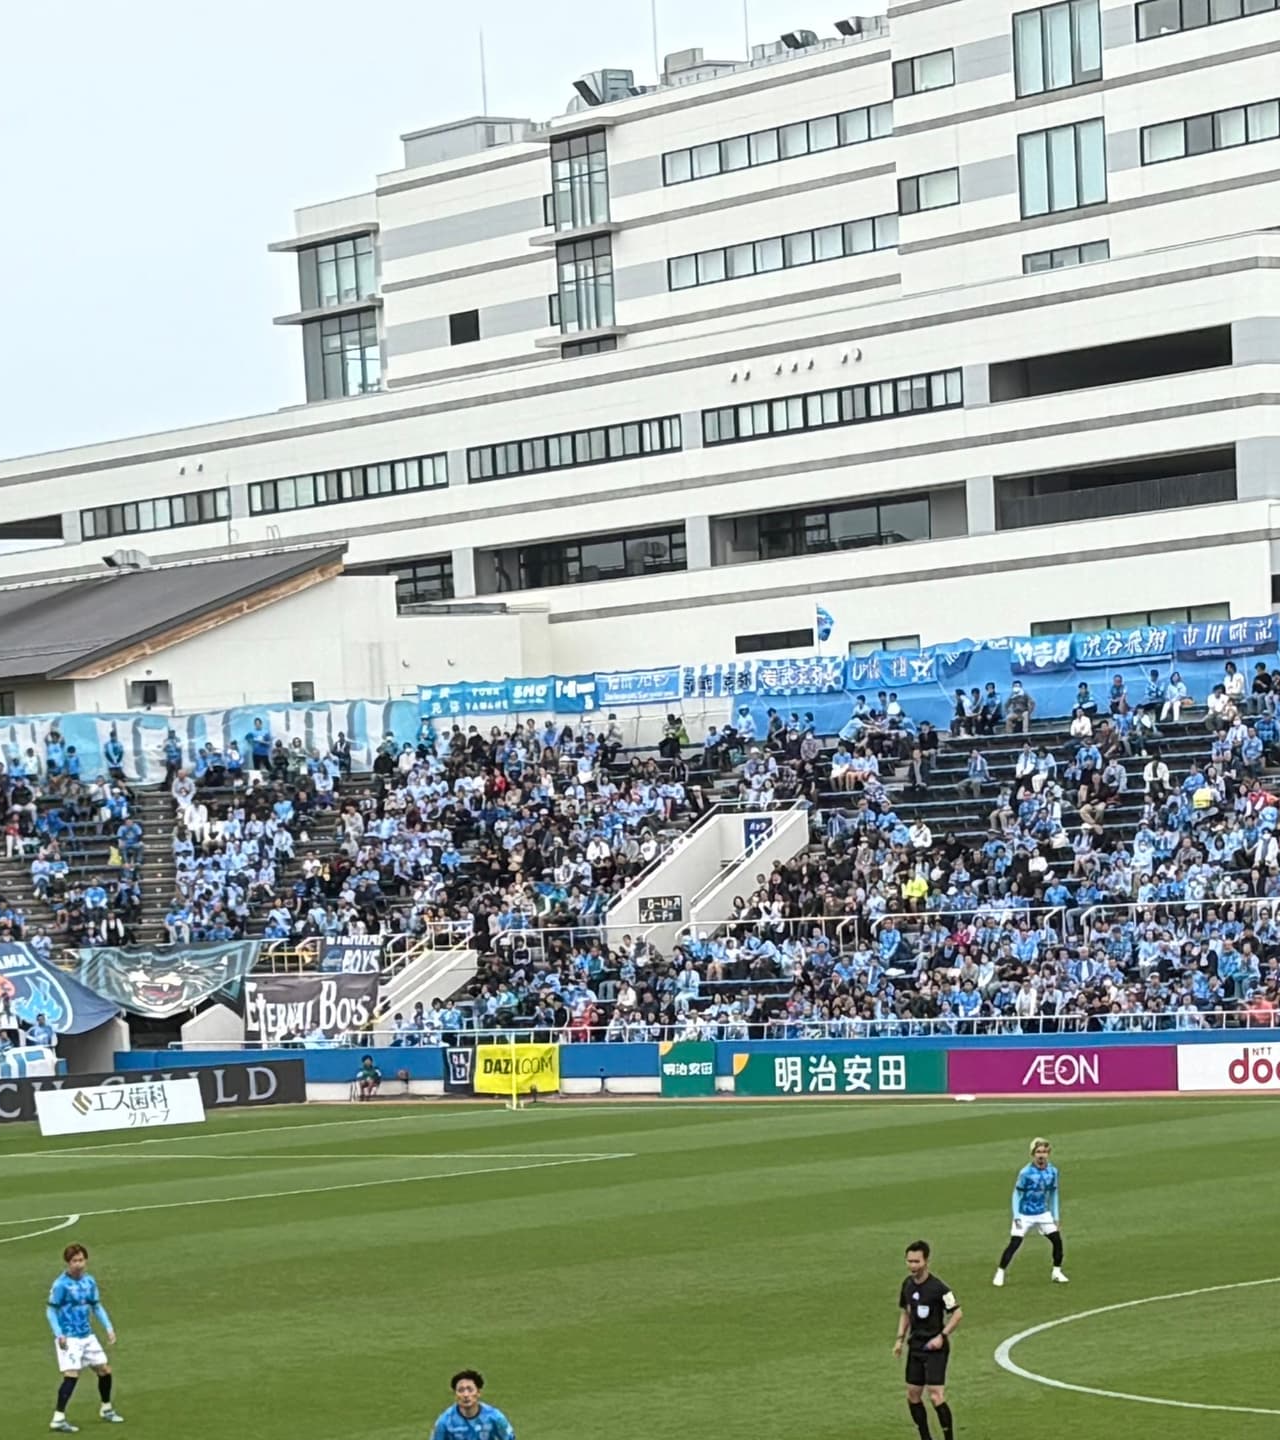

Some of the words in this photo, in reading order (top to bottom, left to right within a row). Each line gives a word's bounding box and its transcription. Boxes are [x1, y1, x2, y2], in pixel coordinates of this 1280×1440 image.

[1251, 1046, 1273, 1056] NTT
[662, 1062, 713, 1077] 明治安田
[774, 1054, 906, 1093] 明治安田
